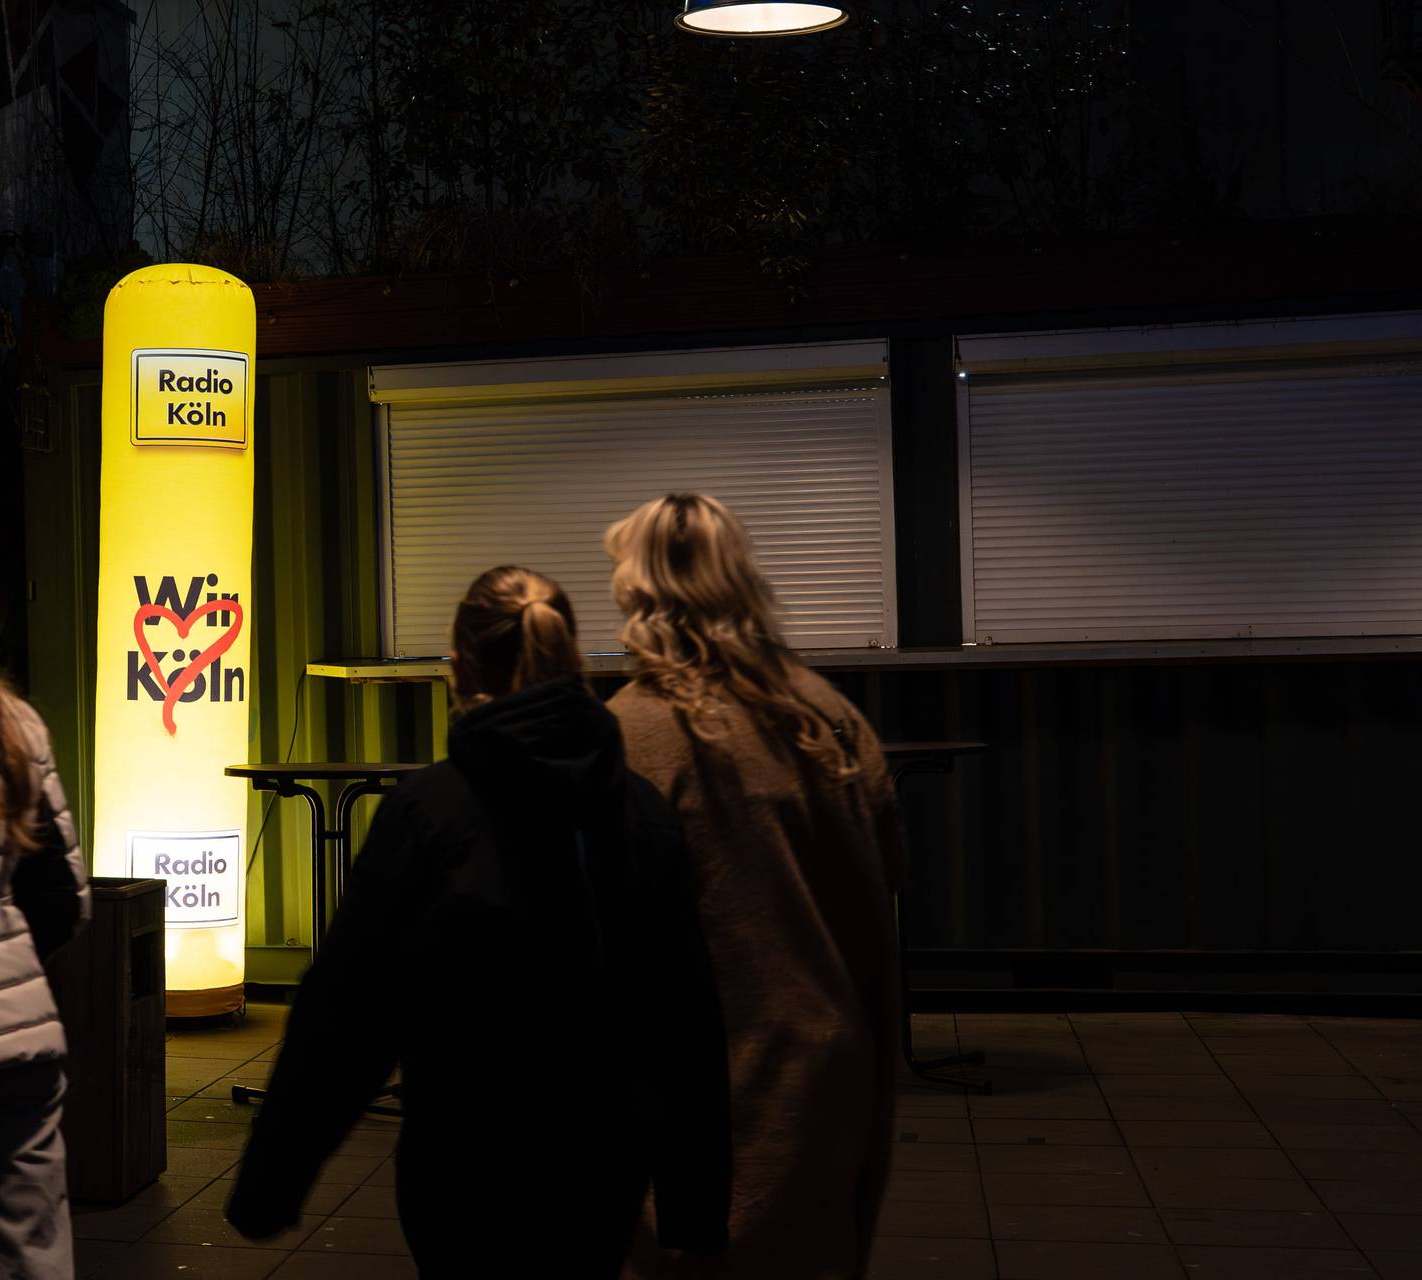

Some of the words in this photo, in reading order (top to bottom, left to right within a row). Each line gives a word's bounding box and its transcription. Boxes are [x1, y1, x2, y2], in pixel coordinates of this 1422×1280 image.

[158, 368, 233, 395] Radio
[167, 401, 226, 427] Köln
[133, 573, 239, 627] Wir
[127, 649, 245, 703] Köln
[154, 850, 227, 876] Radio
[164, 883, 221, 908] Köln
